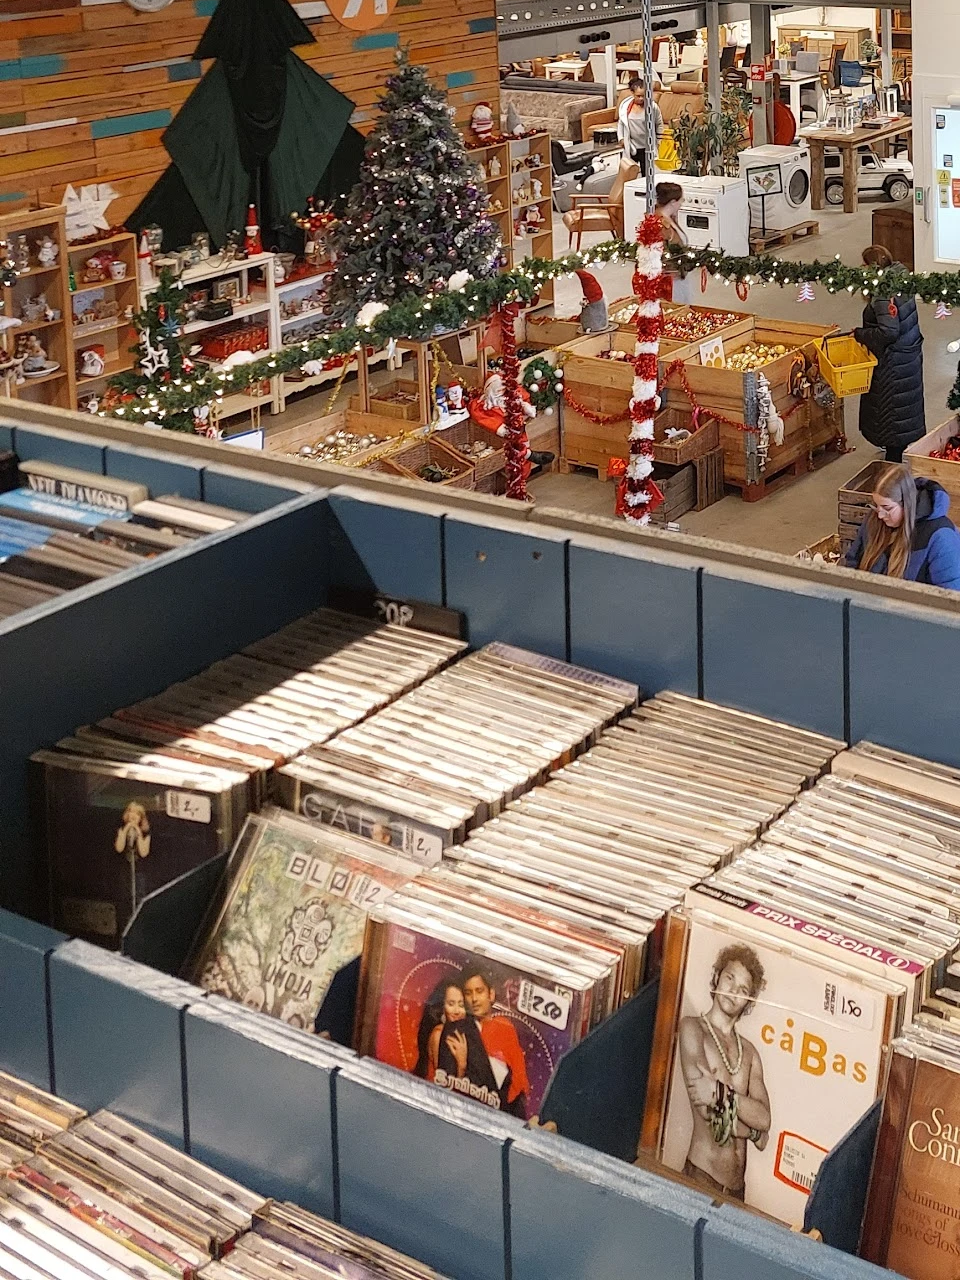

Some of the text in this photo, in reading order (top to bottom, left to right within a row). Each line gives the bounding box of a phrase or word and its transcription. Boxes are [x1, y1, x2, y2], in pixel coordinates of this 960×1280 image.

[752, 905, 802, 928] PRIX
[801, 923, 883, 962] SPÉCIAL
[265, 963, 313, 999] UMOJA
[935, 1217, 950, 1231] of
